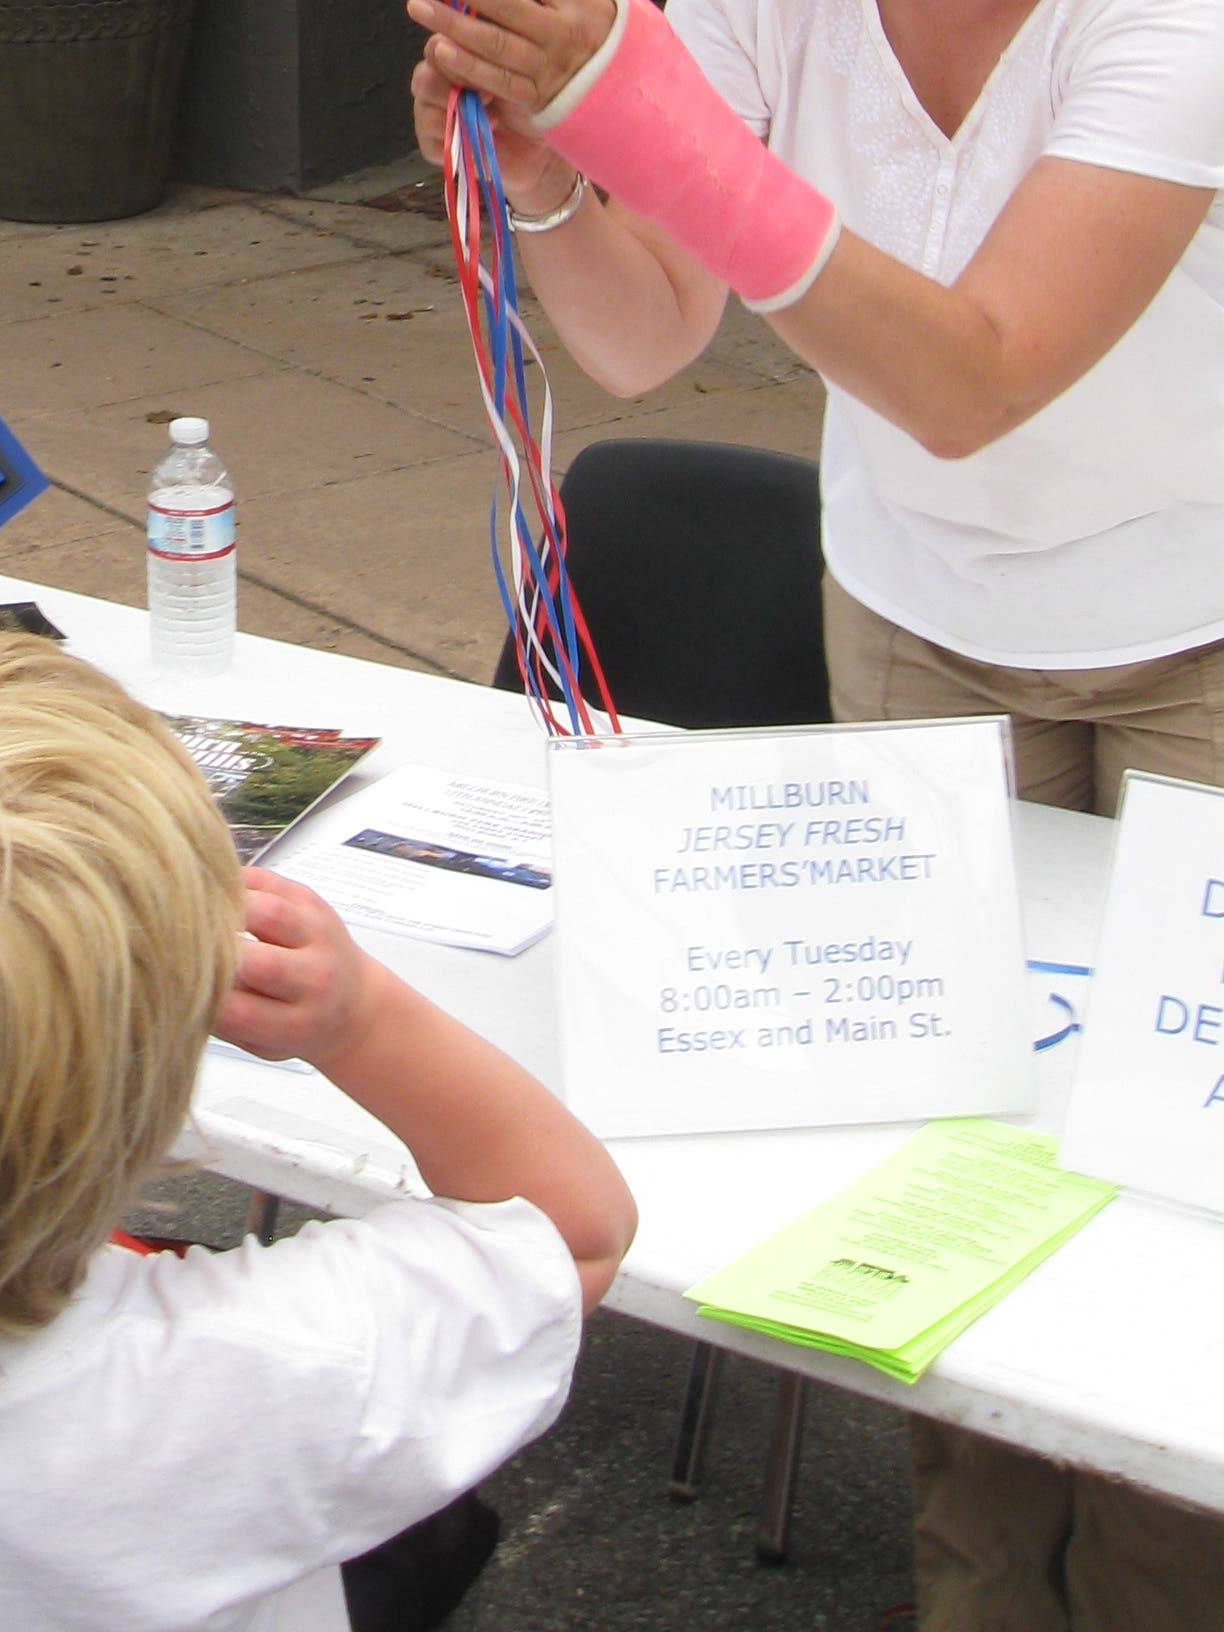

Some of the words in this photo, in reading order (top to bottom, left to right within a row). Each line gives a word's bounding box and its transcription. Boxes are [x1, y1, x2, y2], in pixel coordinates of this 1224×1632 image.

[709, 779, 871, 811] MILLBURN
[676, 822, 796, 854] JERSEY
[803, 816, 908, 847] FRESH
[687, 945, 774, 974] Every
[782, 935, 914, 966] Tuesday
[660, 983, 782, 1013] 8:00am
[824, 974, 945, 1005] 2:00pm
[657, 1026, 746, 1054] Essex
[757, 1018, 814, 1048] and
[826, 1015, 897, 1044] Main
[909, 1011, 953, 1039] St.
